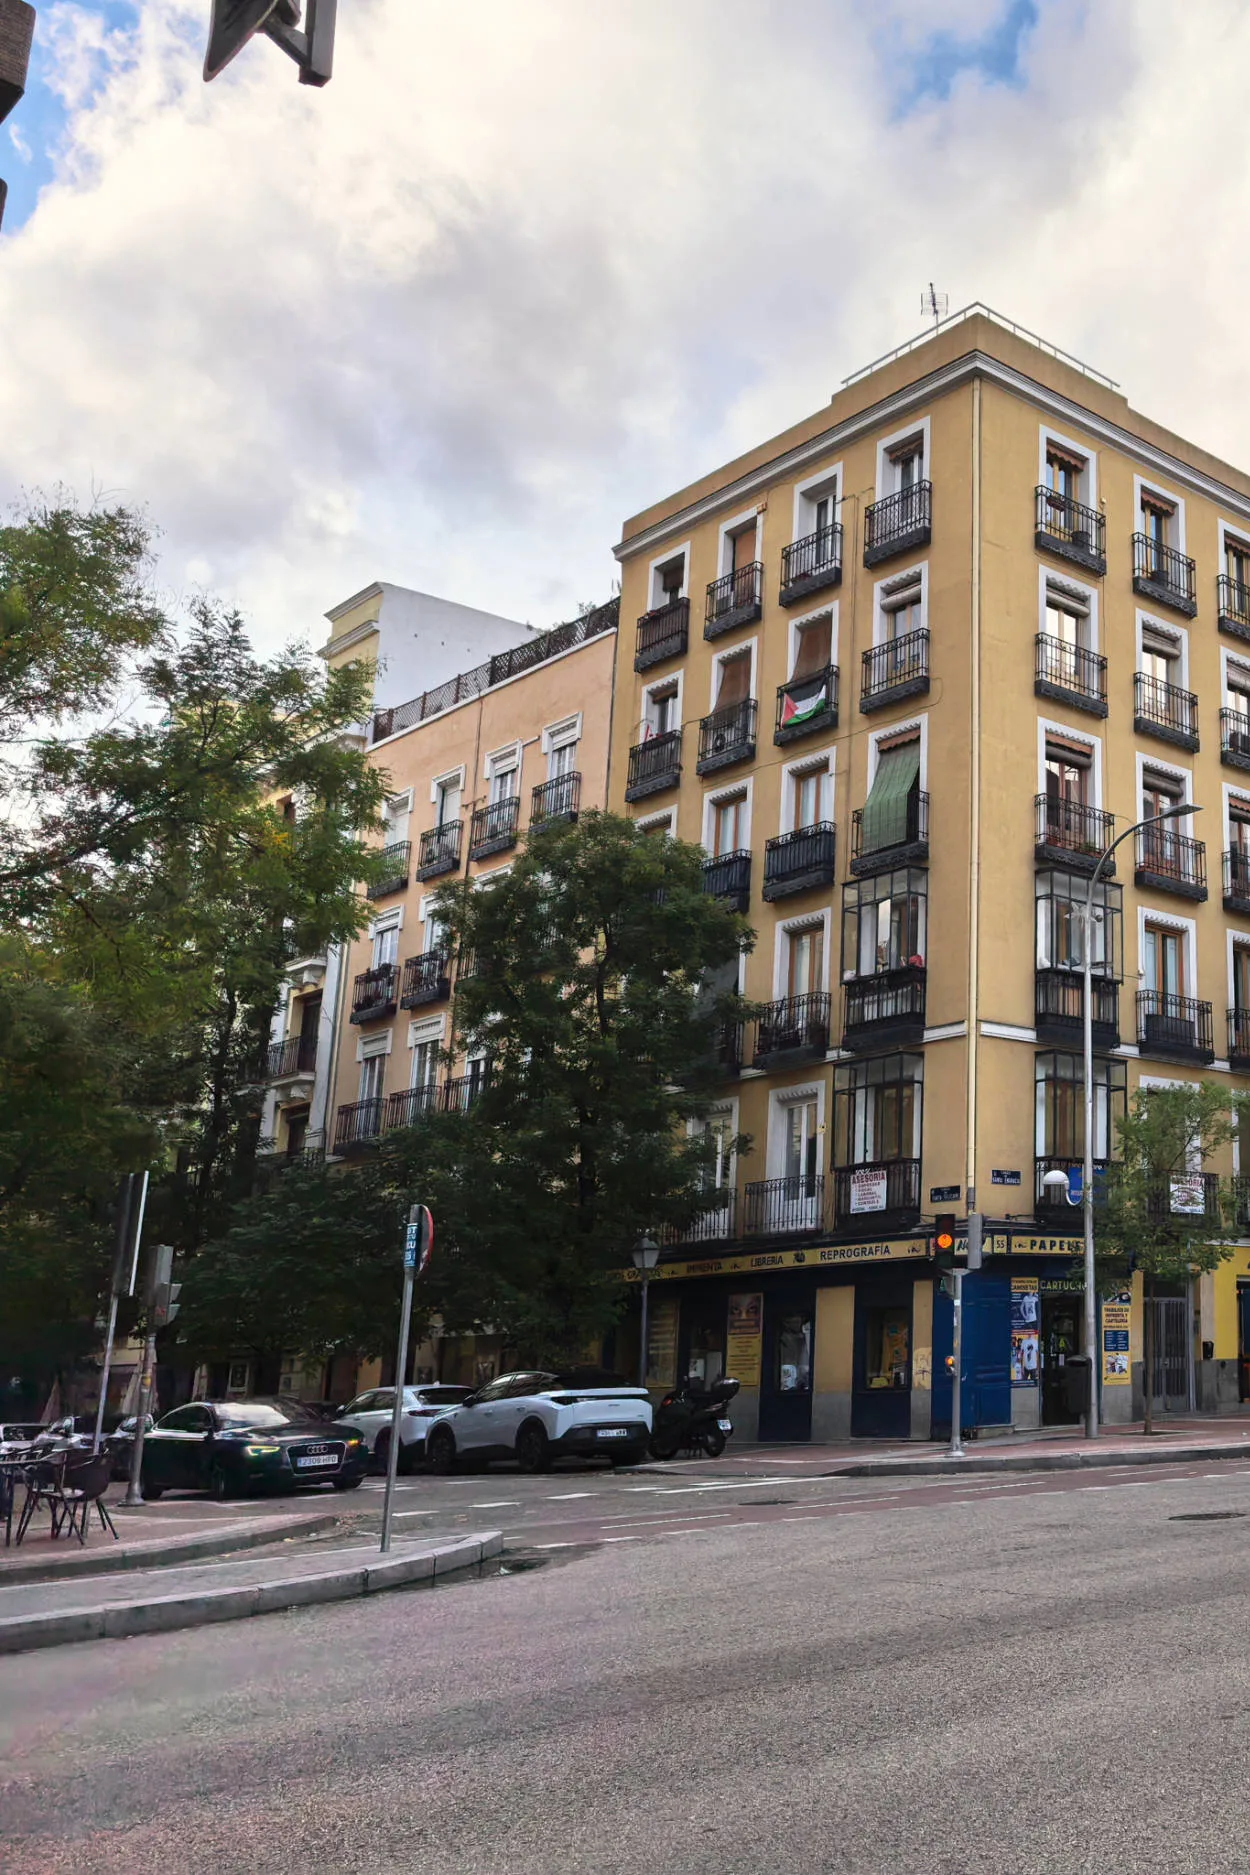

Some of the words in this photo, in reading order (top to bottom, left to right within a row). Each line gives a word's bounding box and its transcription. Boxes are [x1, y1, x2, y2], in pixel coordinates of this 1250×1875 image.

[851, 1171, 886, 1184] ASESORIA
[996, 1240, 1005, 1249] 55
[820, 1242, 892, 1261] REPROGRAFÍA
